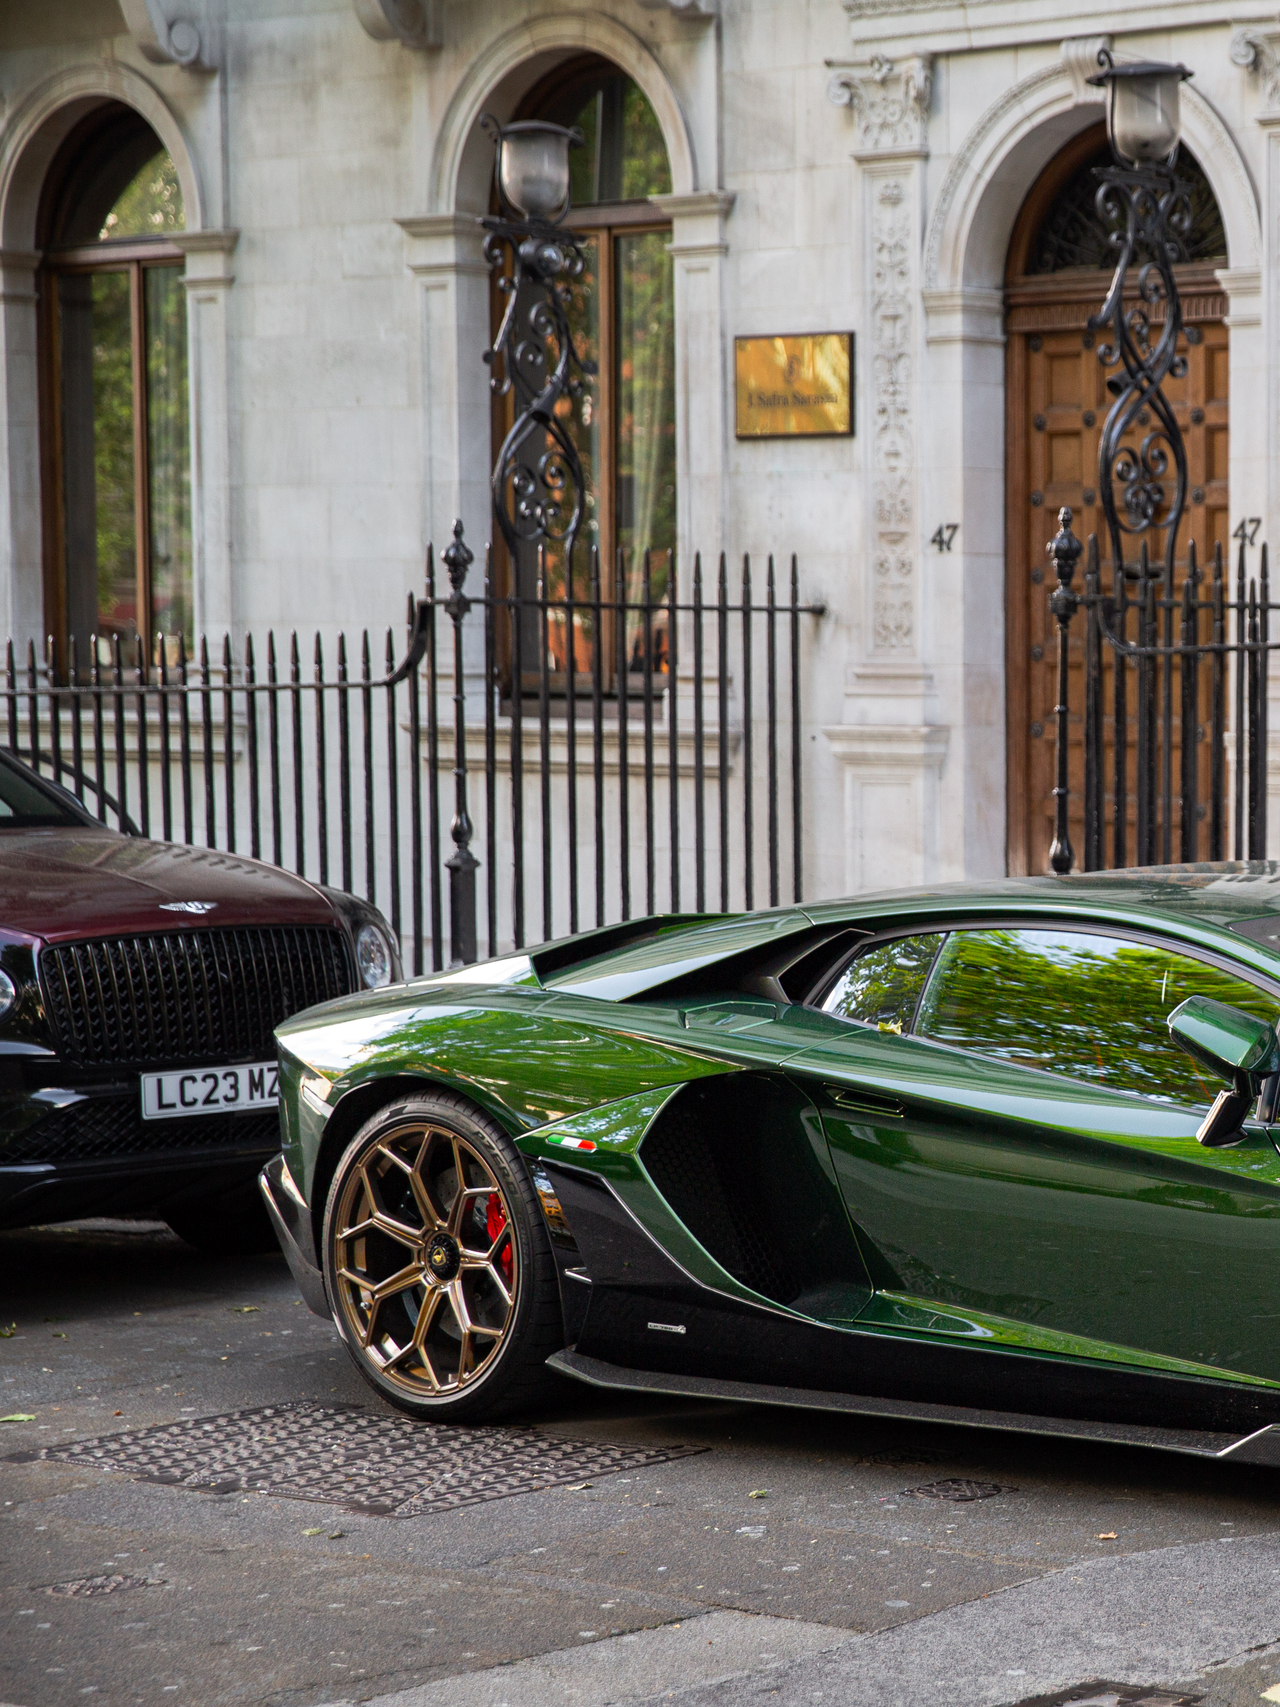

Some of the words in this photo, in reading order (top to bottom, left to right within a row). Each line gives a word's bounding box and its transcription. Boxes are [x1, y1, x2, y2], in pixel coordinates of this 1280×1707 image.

[931, 522, 960, 552] 47
[1232, 516, 1262, 547] 47
[156, 1070, 240, 1111] LC23
